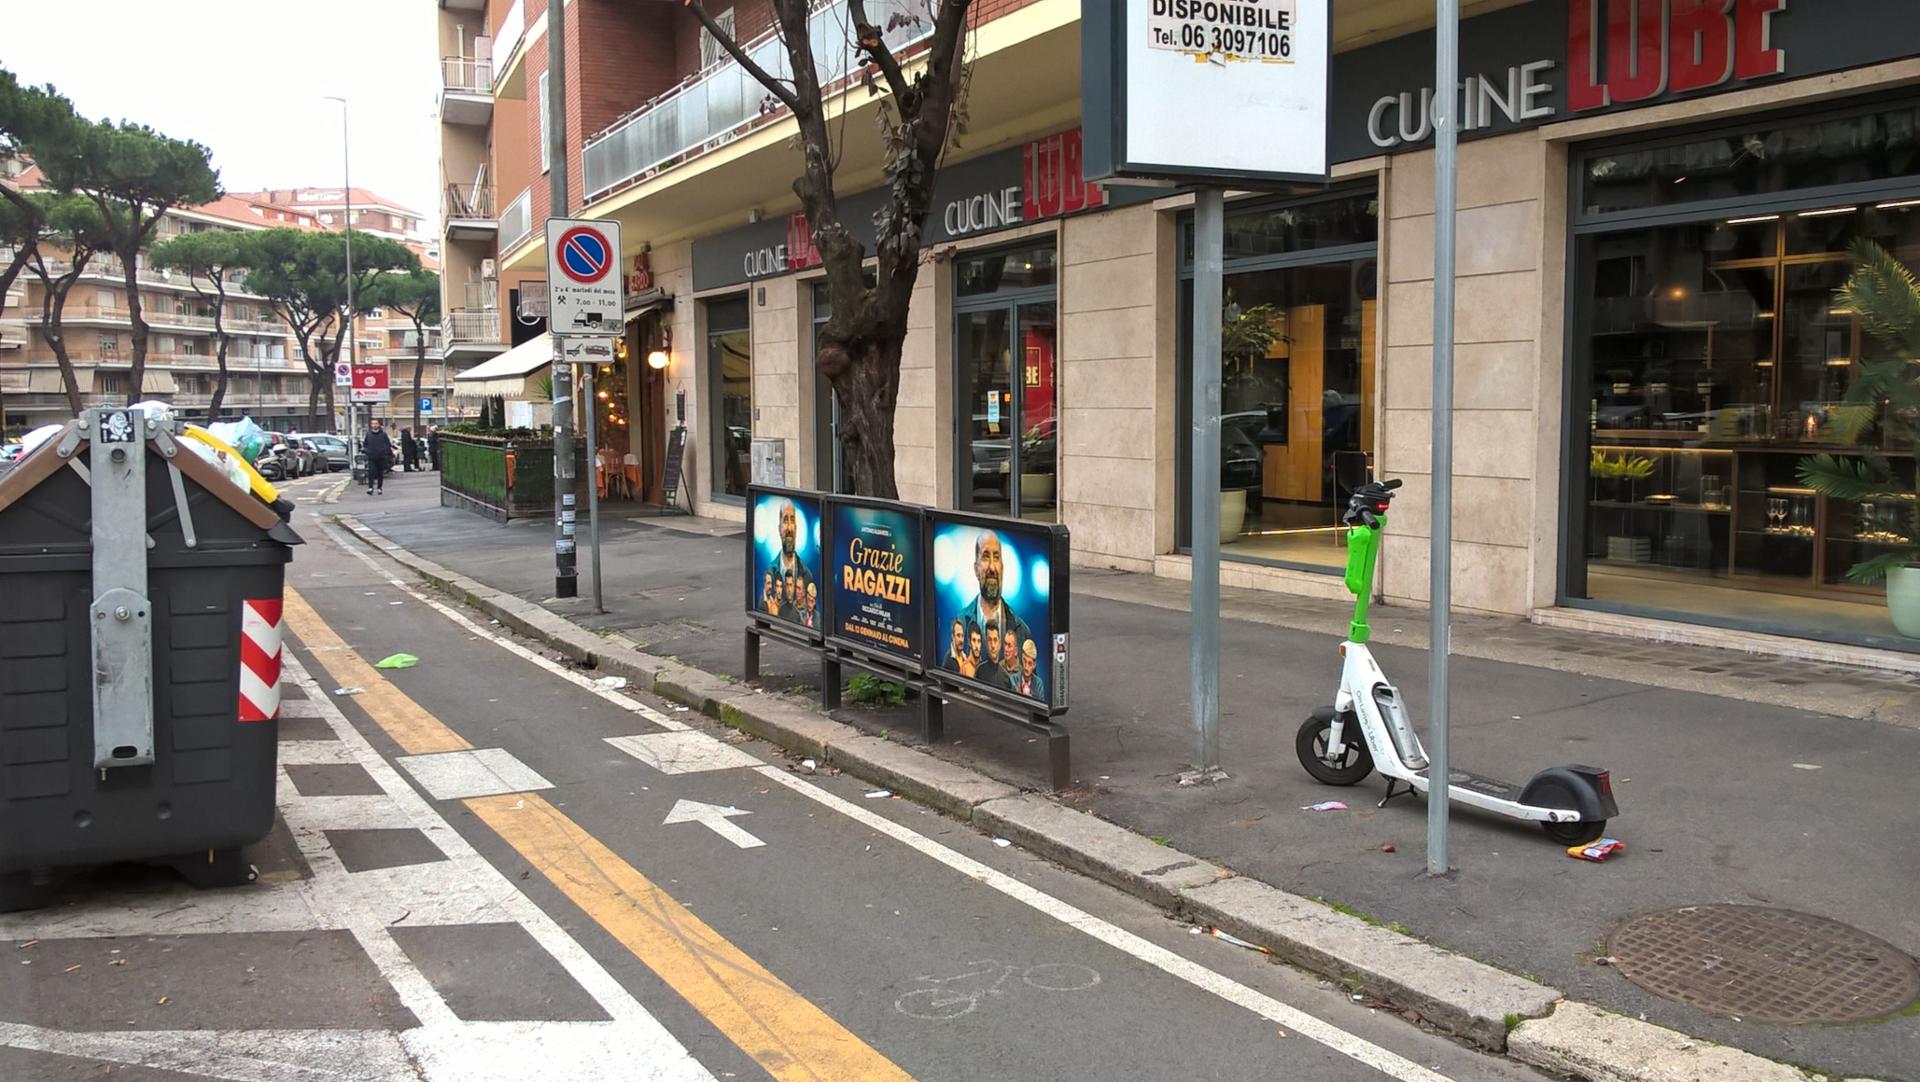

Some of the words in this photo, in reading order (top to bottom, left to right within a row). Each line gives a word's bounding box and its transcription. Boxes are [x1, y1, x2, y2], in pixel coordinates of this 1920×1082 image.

[1152, 0, 1290, 31] DISPONIBILE
[1153, 27, 1177, 46] Tel.
[1181, 23, 1205, 49] 06
[1211, 26, 1291, 57] 3097106
[945, 186, 1024, 236] CUCINE
[1024, 128, 1110, 220] LUB
[745, 244, 788, 278] CUCINE
[422, 399, 430, 409] P
[850, 537, 904, 573] Grazie
[843, 564, 910, 605] RAGAZZI
